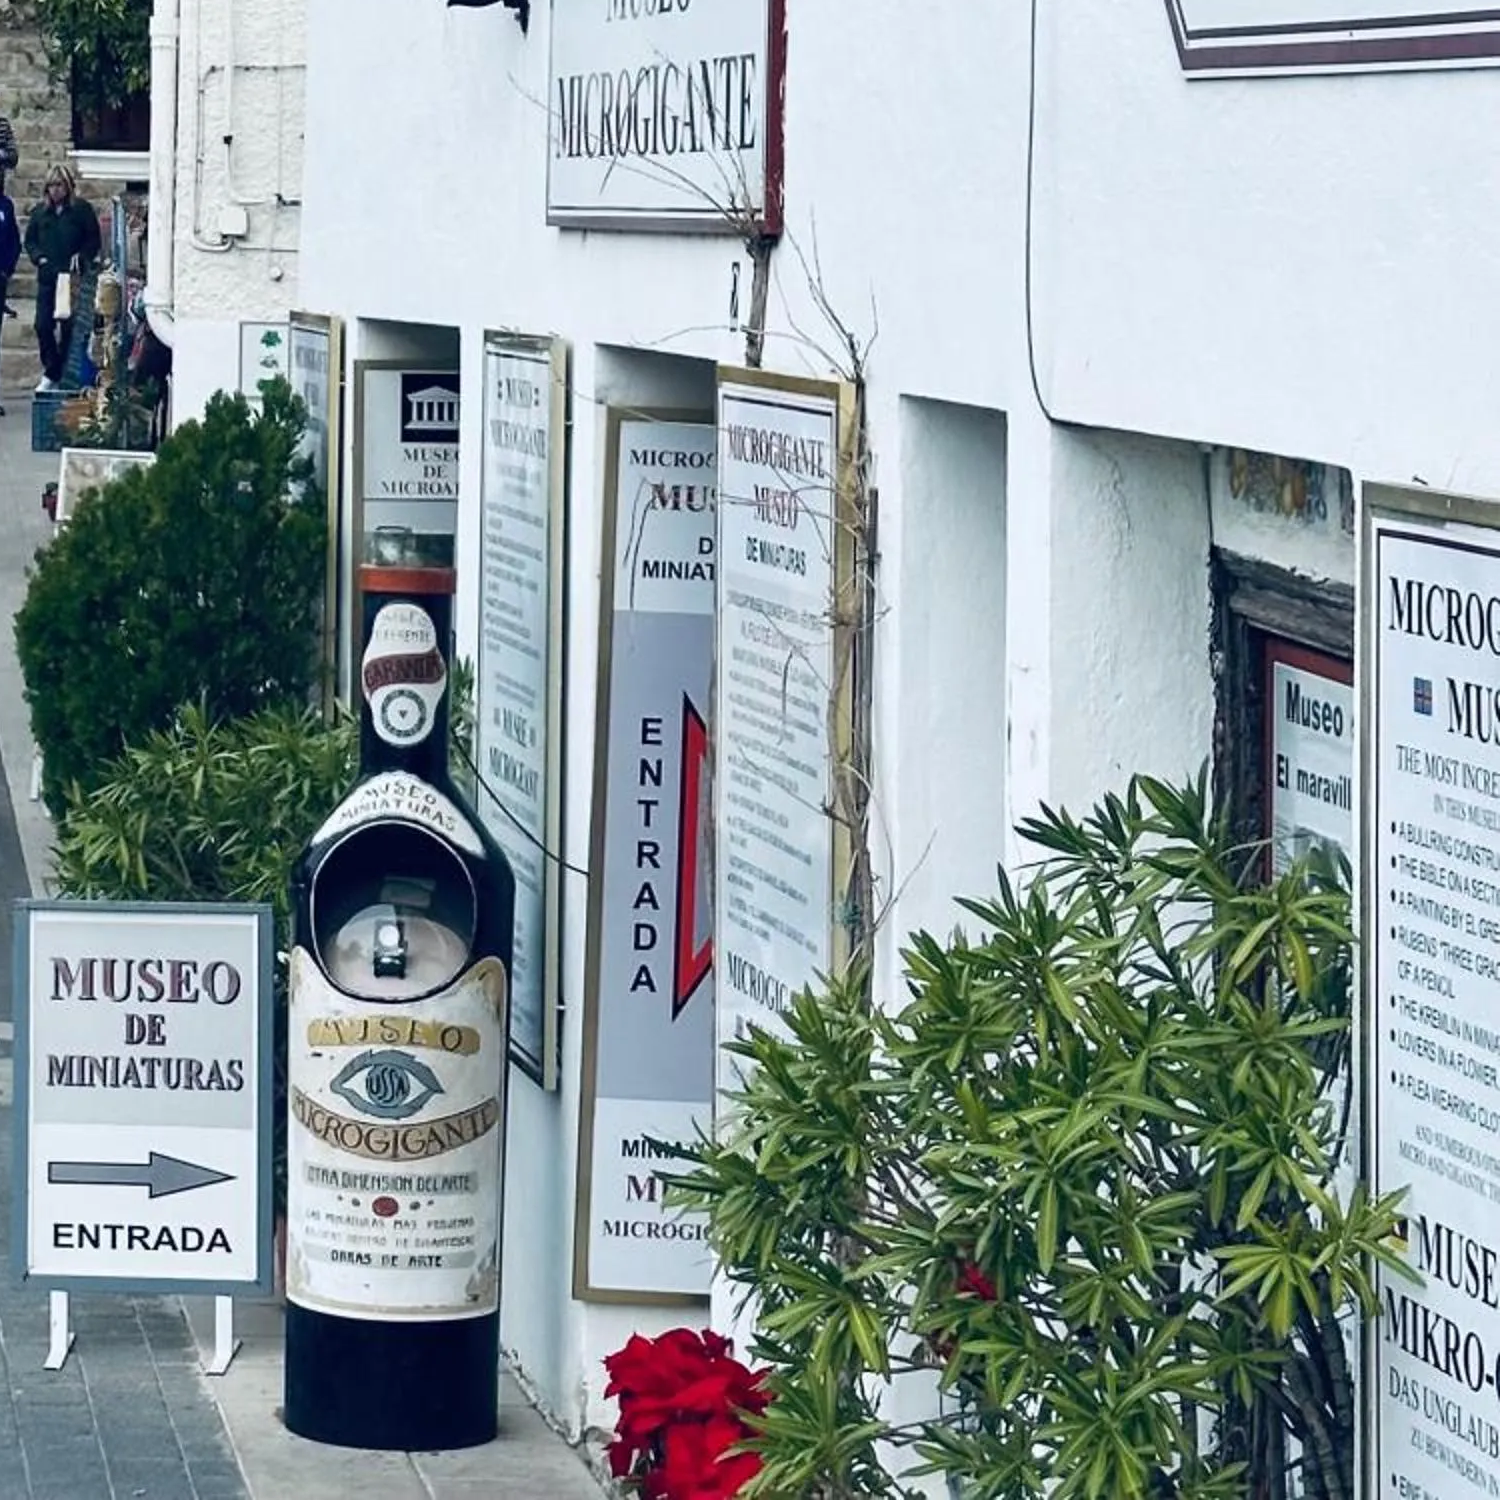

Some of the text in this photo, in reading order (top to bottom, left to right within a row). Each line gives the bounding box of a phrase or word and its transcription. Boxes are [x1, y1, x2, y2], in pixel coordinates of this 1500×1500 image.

[556, 53, 757, 159] MICROGIGANTE
[404, 448, 459, 461] MUSE
[728, 423, 826, 479] MICROGIGANTE
[423, 465, 446, 478] DE
[754, 484, 800, 531] MUSEO
[1285, 680, 1344, 738] Museo
[1276, 753, 1289, 790] El
[1396, 744, 1421, 775] THE
[1424, 752, 1459, 787] MOST
[363, 782, 437, 805] MUSEO
[341, 798, 457, 832] MINIATURAS
[630, 717, 663, 993] ENTRADA
[50, 956, 241, 1005] MUSEO
[125, 1013, 166, 1045] DE
[47, 1054, 244, 1092] MINIATURAS
[295, 1092, 499, 1159] MICROGIGANTE
[307, 1165, 340, 1188] OTRA
[342, 1168, 413, 1192] DIMENSION
[53, 1222, 232, 1253] ENTRADA
[408, 1253, 443, 1268] ARTE
[1385, 1285, 1500, 1403] MIKRO-
[1389, 1365, 1499, 1460] DAS UNGLAUB
